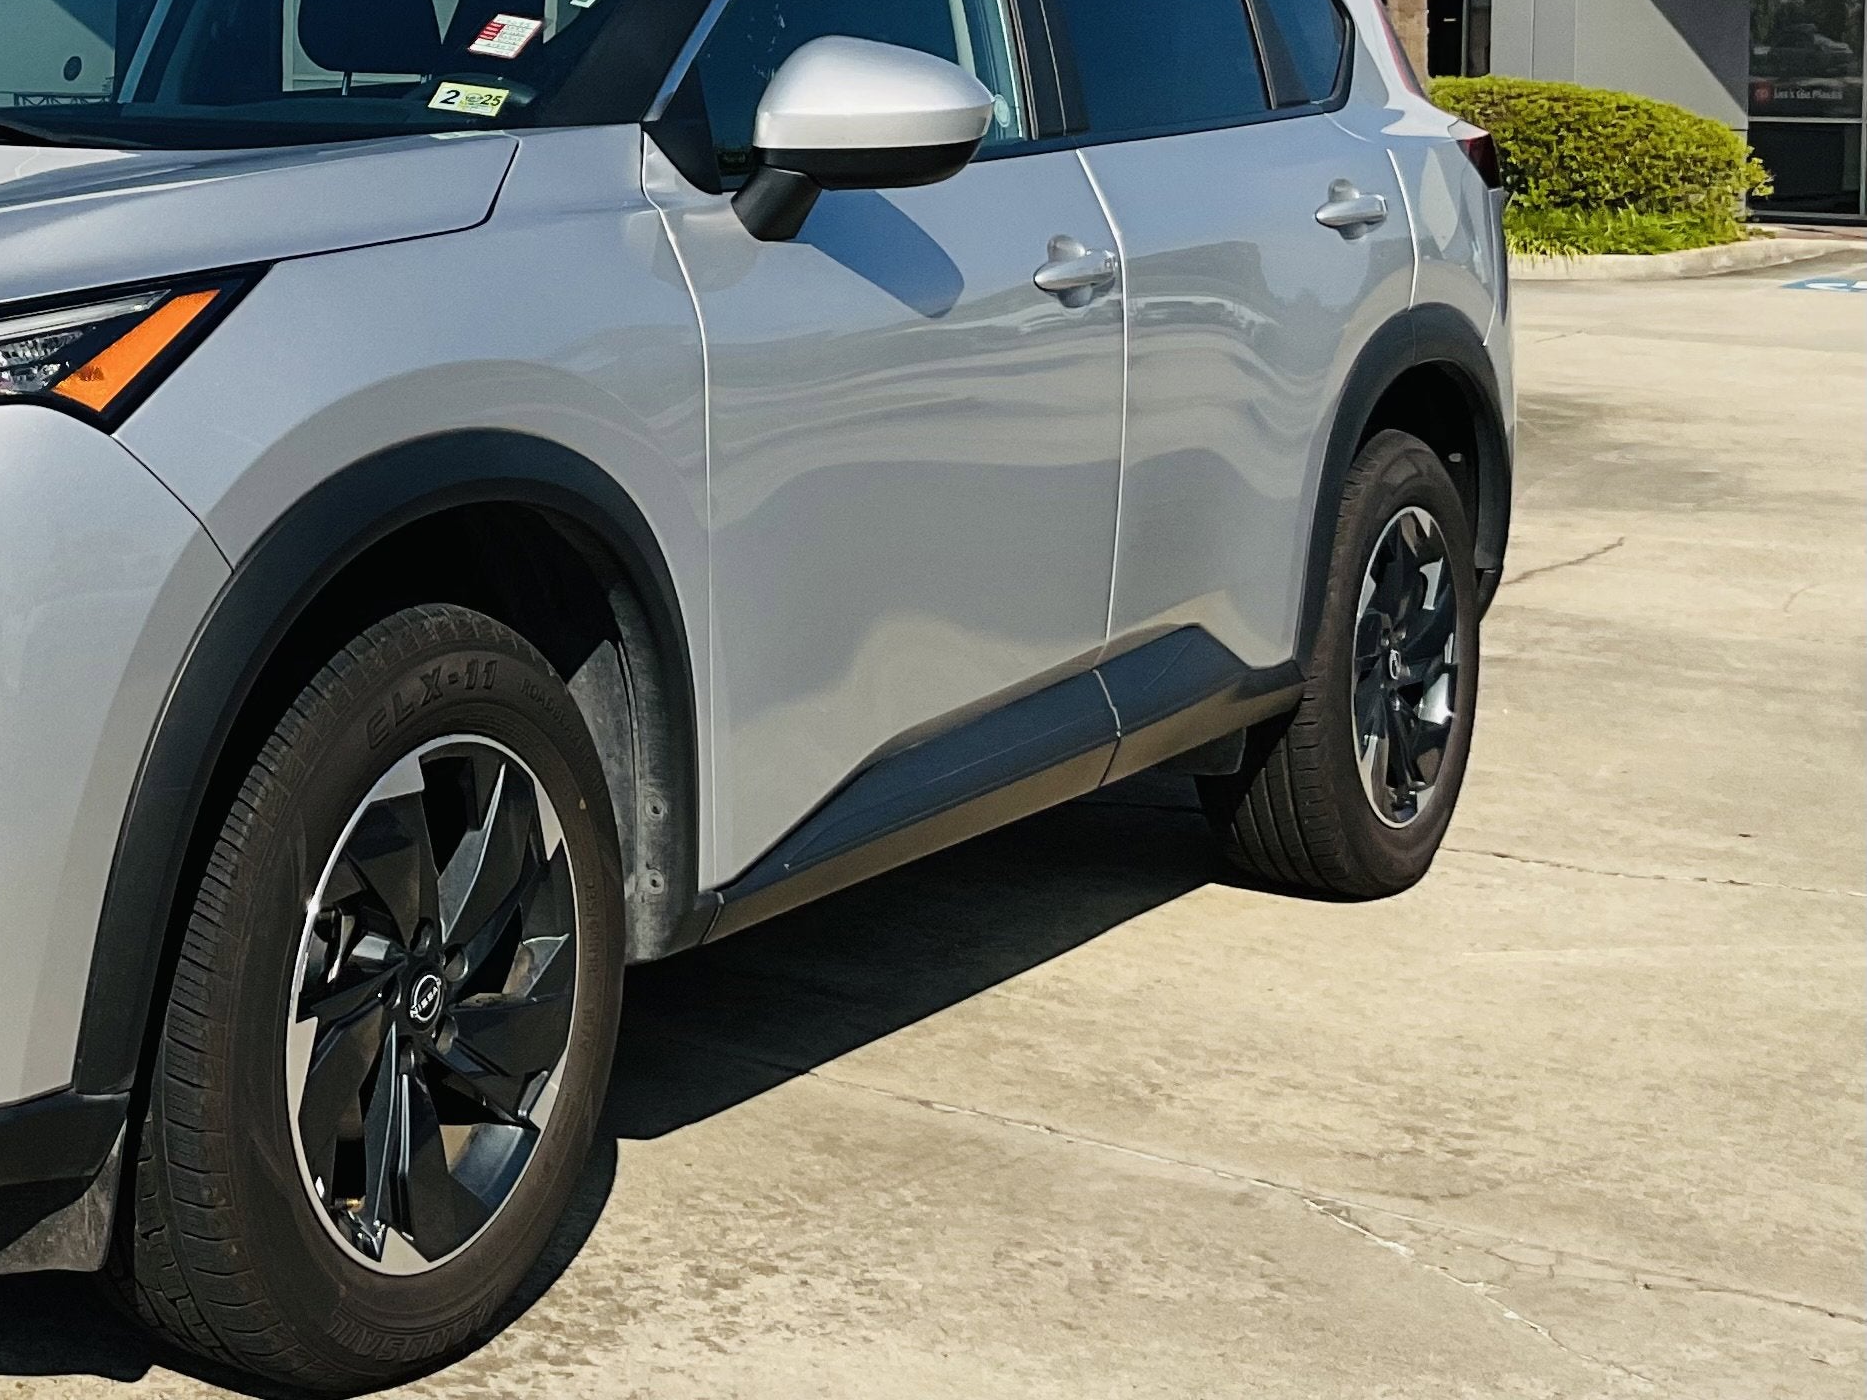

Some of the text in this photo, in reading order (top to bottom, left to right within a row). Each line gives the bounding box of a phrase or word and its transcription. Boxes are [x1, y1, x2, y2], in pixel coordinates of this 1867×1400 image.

[439, 89, 461, 105] 2
[479, 94, 503, 107] 25
[365, 658, 499, 750] CLX-11
